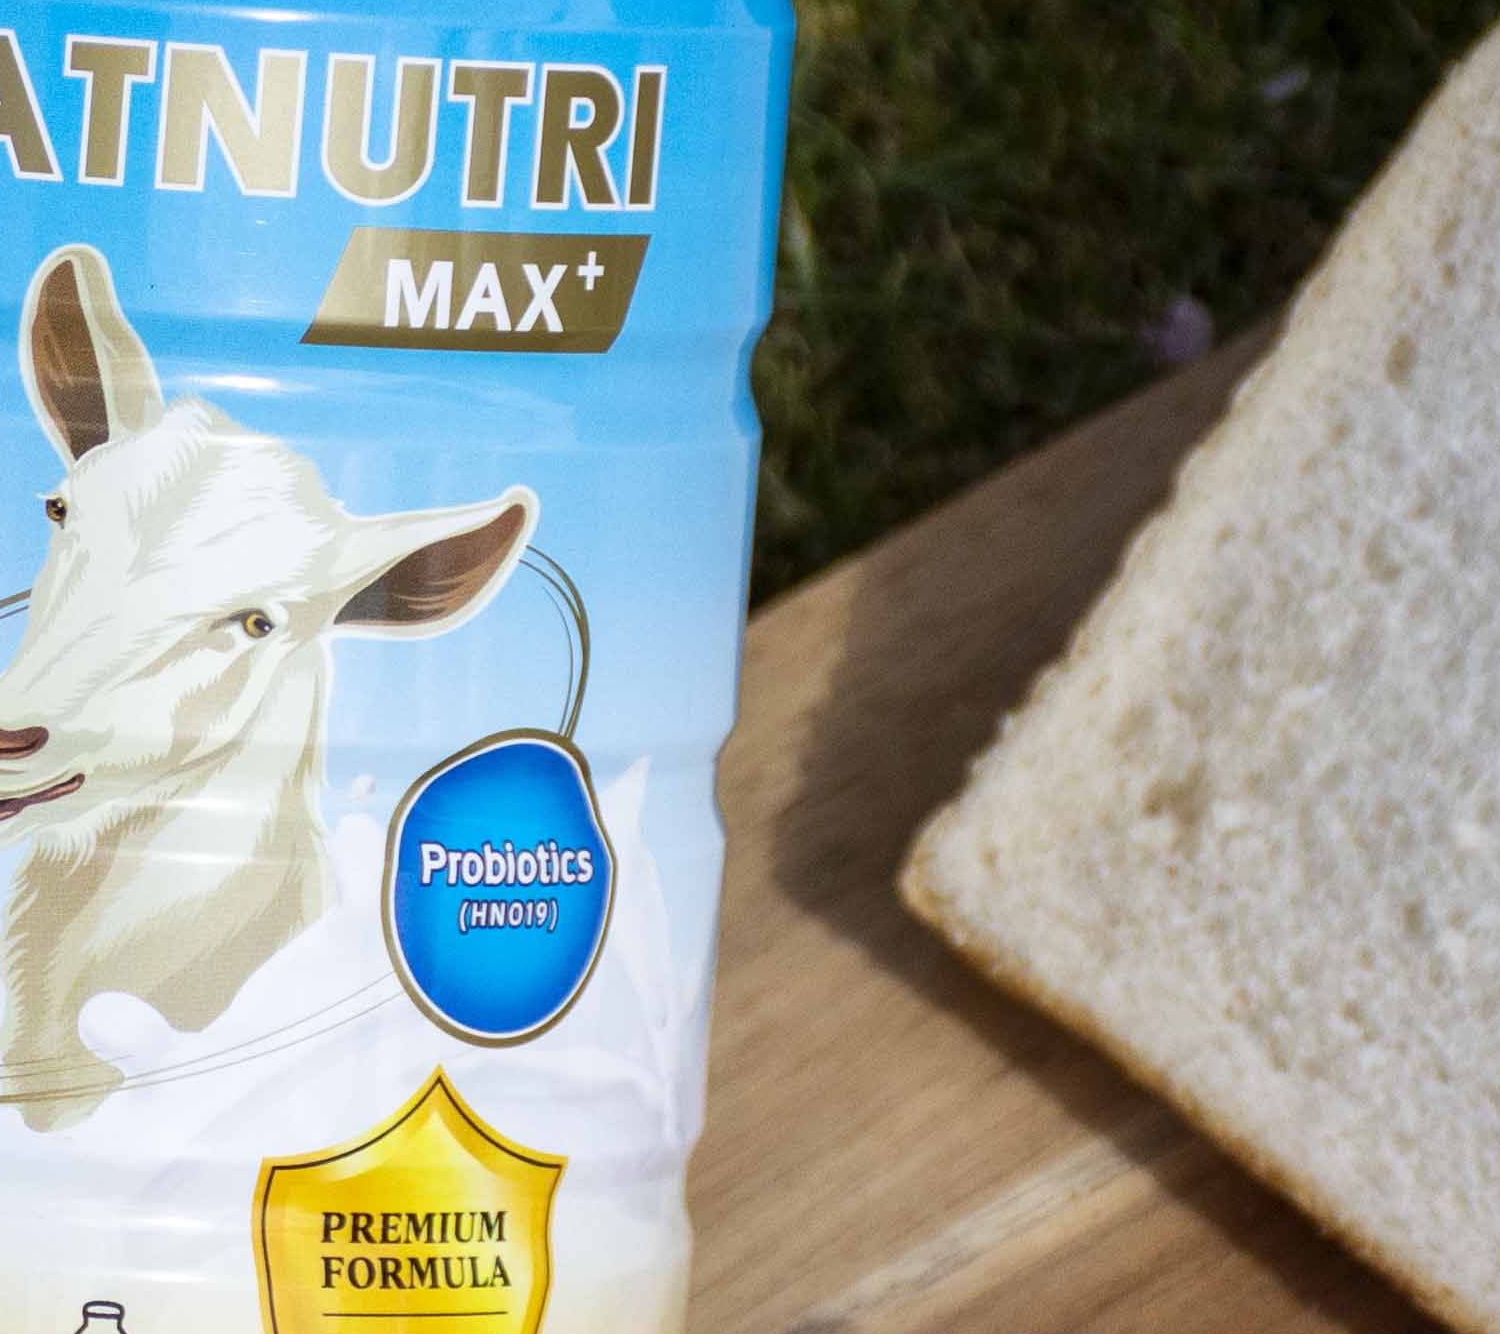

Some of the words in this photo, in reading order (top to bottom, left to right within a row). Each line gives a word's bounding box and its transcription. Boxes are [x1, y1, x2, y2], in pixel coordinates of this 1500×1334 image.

[383, 250, 603, 335] MAX+
[420, 840, 595, 886] Probiotics
[320, 1211, 509, 1245] PREMIUM
[320, 1255, 512, 1290] FORMULA
